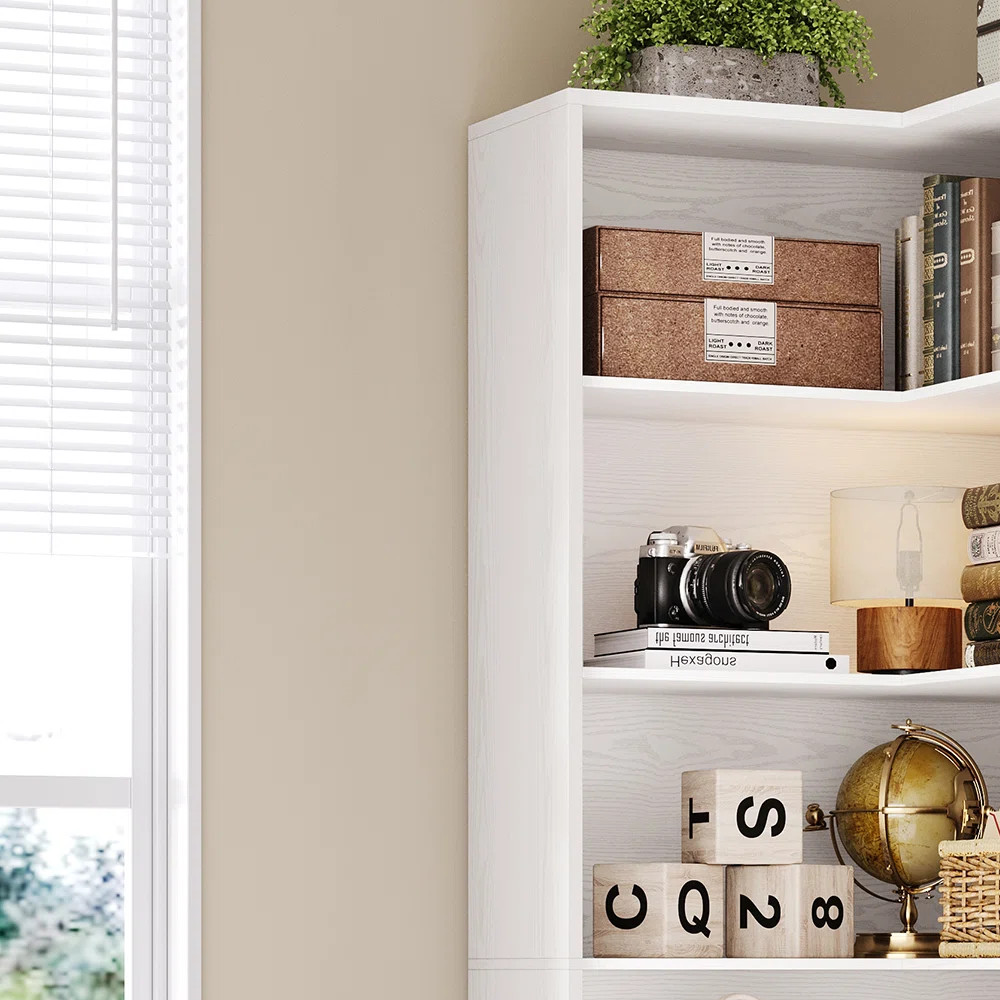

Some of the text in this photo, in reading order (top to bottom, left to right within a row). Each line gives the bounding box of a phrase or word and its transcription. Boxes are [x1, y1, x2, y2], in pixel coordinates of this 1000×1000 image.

[688, 797, 710, 839] T
[736, 795, 787, 839] S
[605, 884, 648, 930] C
[678, 879, 711, 939] Q
[739, 894, 782, 929] 2
[811, 895, 844, 930] 8
